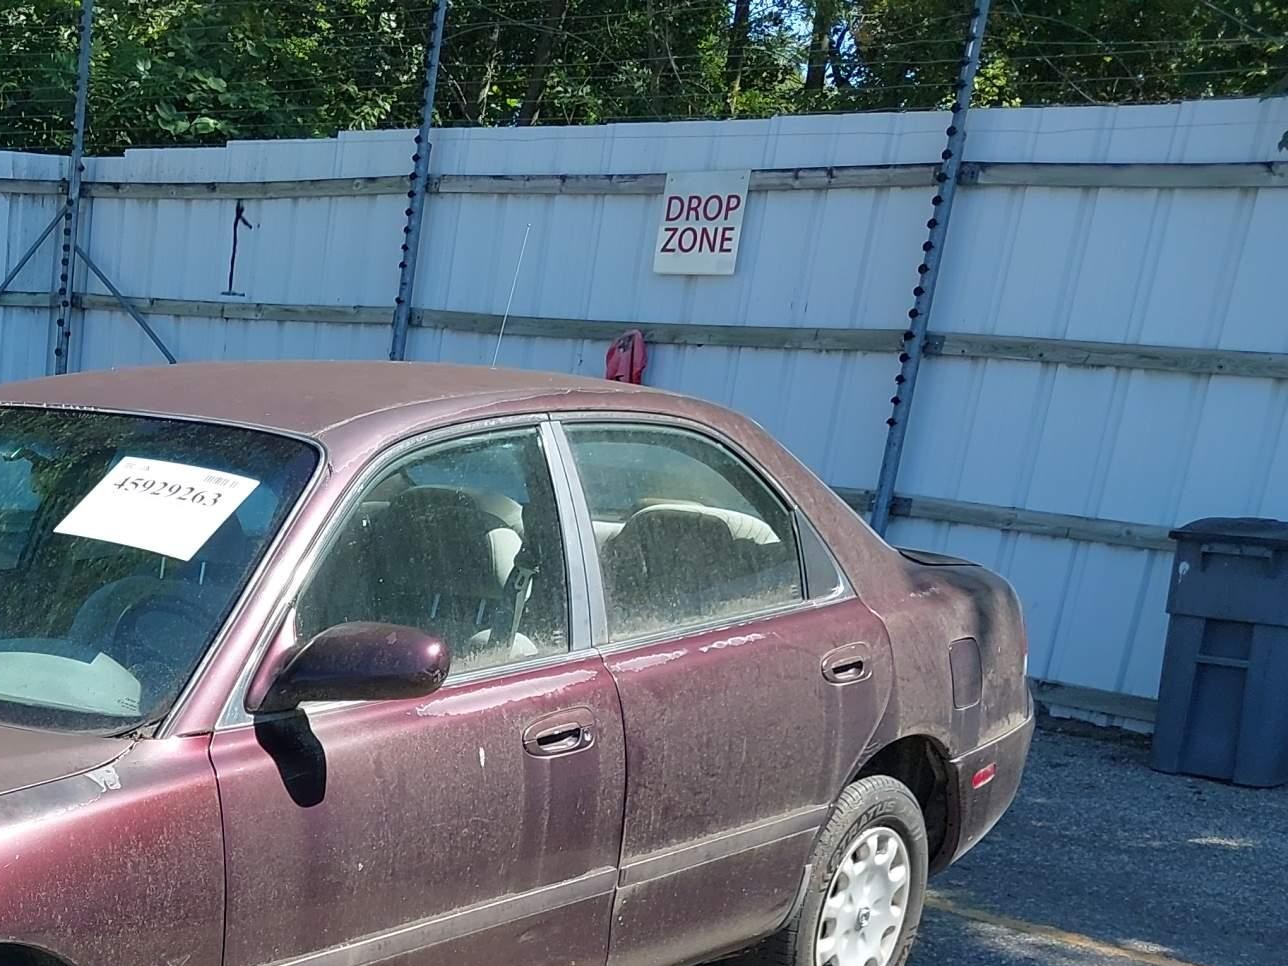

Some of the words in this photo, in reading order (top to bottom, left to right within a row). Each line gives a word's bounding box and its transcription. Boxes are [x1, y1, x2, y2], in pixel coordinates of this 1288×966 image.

[665, 194, 742, 222] DROP
[660, 226, 736, 253] ZONE
[114, 475, 223, 507] 45929263
